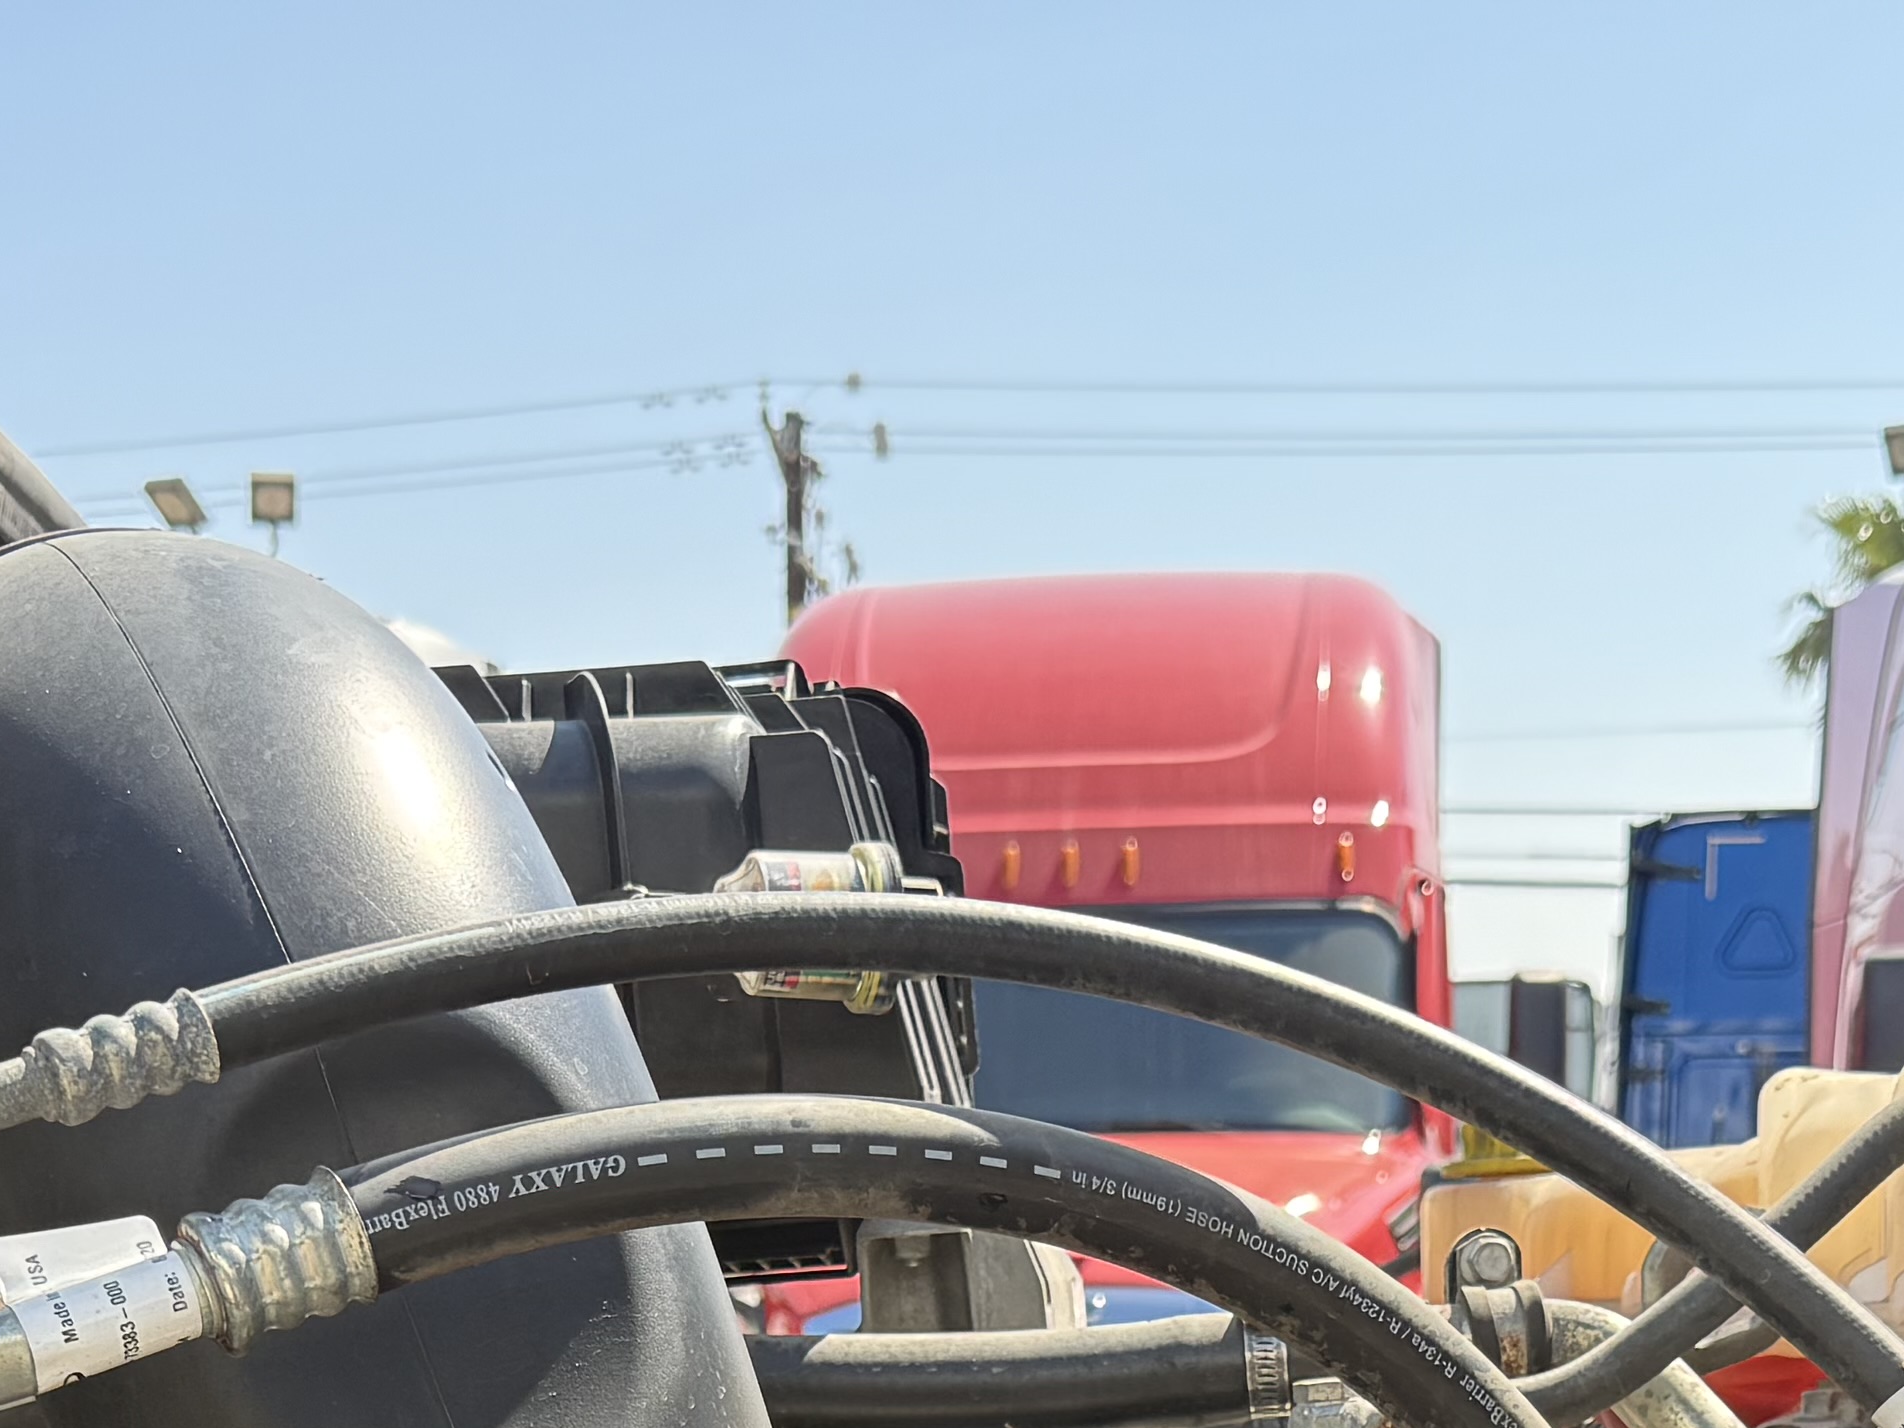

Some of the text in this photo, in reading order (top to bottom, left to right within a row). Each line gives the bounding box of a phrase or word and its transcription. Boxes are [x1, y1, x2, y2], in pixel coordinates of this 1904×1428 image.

[363, 1154, 626, 1236] GALAXY 4880 FlexBarr
[1071, 1170, 1087, 1184] in
[1091, 1174, 1116, 1195] 3/4
[1121, 1181, 1182, 1217] (19mm)
[1185, 1205, 1234, 1239] HOSE
[25, 1253, 48, 1285] USA
[1235, 1227, 1309, 1276] SUCTION
[164, 1271, 189, 1313] Date:
[1308, 1265, 1339, 1294] A/C
[52, 1299, 80, 1344] Made
[1338, 1279, 1404, 1335] R-1234yf
[1406, 1332, 1460, 1379] R-134a
